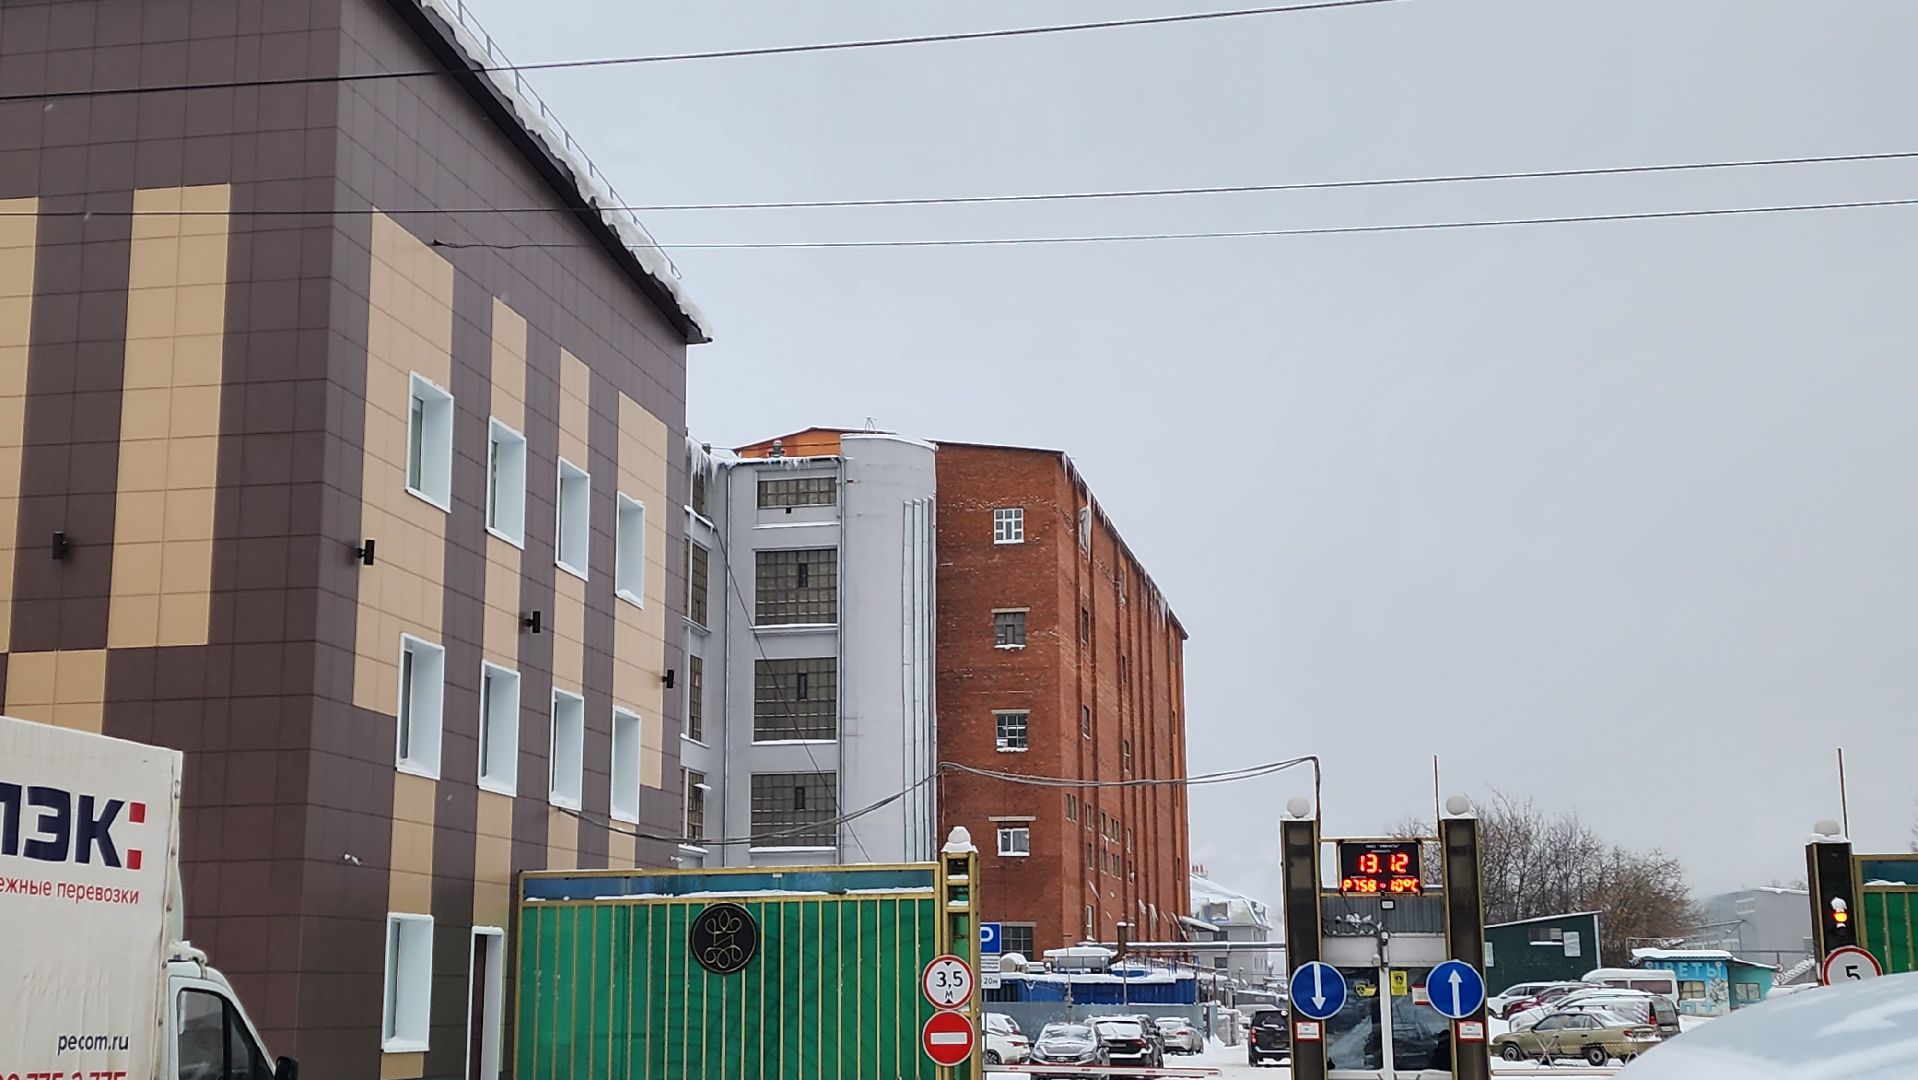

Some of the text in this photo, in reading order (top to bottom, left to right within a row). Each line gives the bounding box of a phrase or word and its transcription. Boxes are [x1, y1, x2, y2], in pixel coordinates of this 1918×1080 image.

[57, 882, 140, 904] перевозки
[936, 971, 963, 989] 3,5
[1845, 965, 1861, 980] 5
[57, 1034, 129, 1056] pecom.ru
